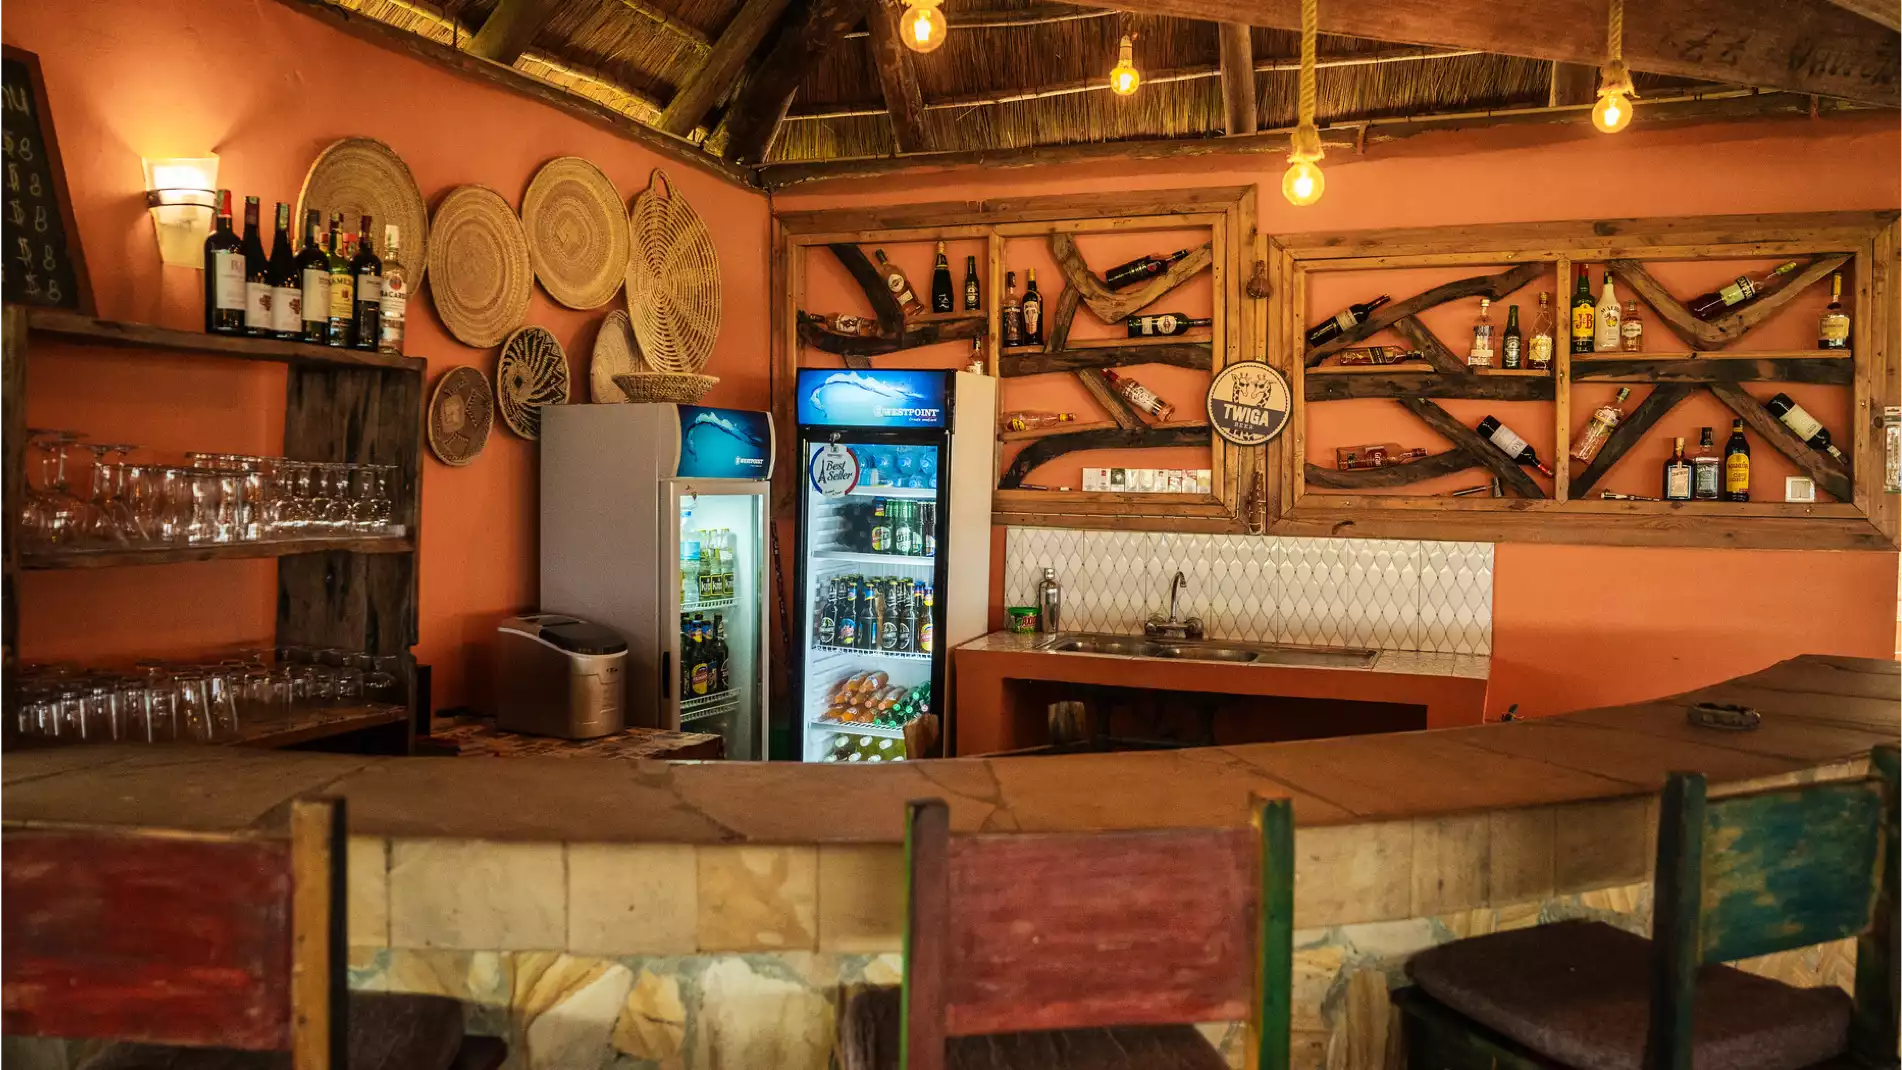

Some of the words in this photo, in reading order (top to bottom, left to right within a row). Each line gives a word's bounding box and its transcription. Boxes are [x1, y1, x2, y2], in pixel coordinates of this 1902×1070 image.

[883, 408, 937, 417] WESTPOINT
[1223, 403, 1269, 427] TWIGA
[1234, 422, 1255, 430] BEER
[826, 460, 846, 471] Best
[826, 470, 853, 481] Seller
